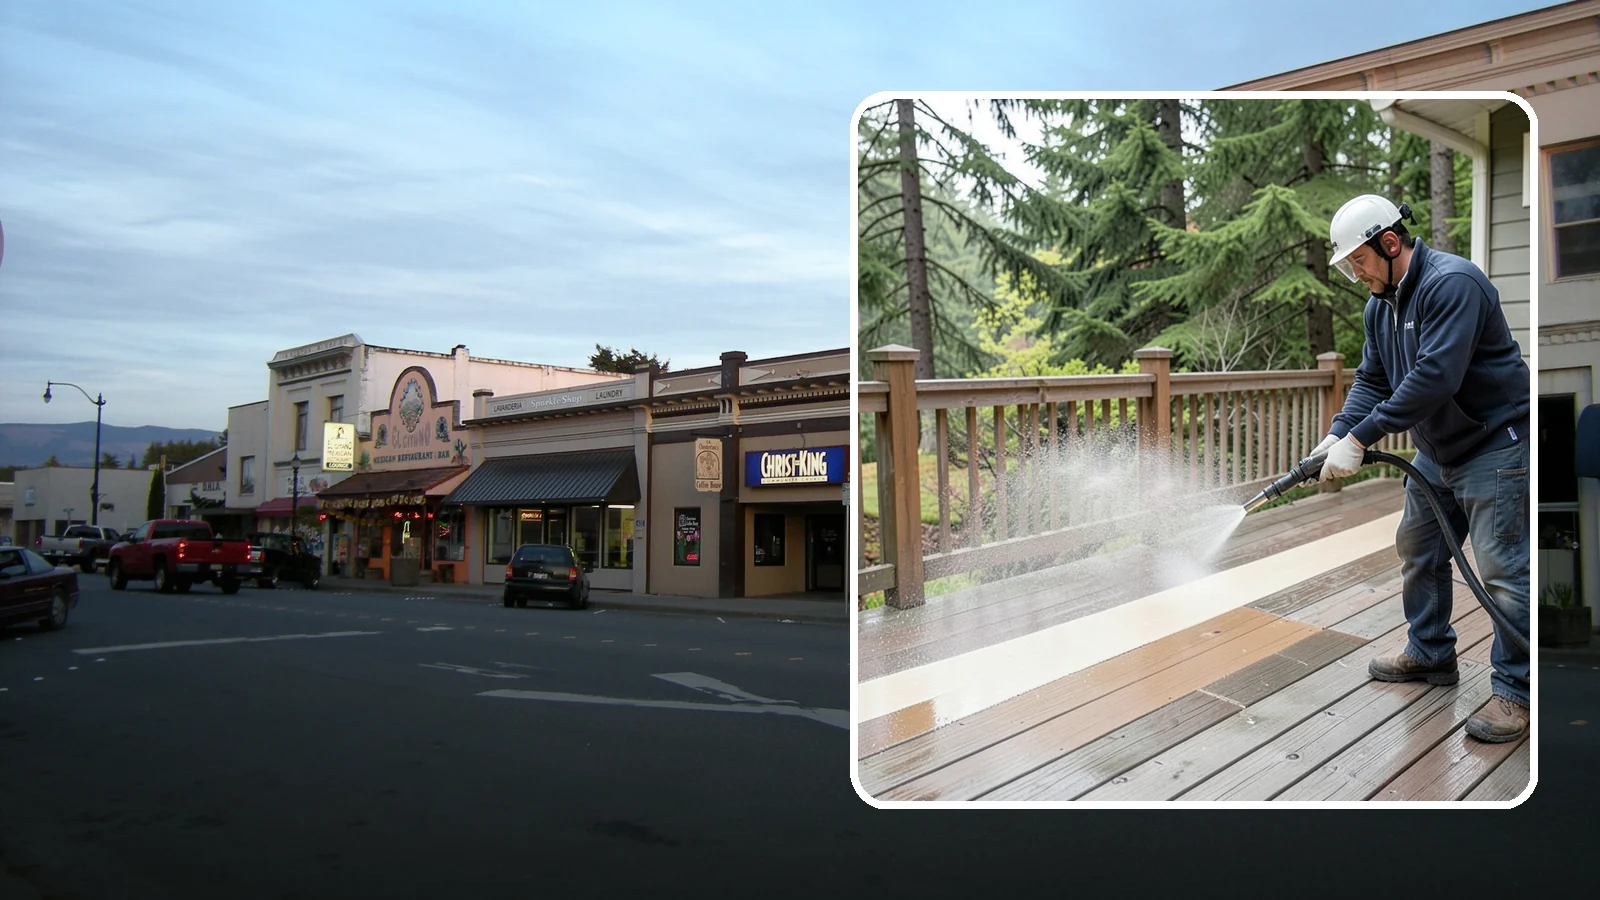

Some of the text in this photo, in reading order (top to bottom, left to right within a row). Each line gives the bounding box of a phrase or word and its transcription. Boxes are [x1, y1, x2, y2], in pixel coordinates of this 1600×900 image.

[493, 389, 624, 412] LAVANDERIA Sparkle Shop LAUNDRY
[373, 454, 396, 464] MEXICAN
[397, 451, 433, 462] RESTAURANT
[438, 450, 450, 459] BAR
[761, 450, 827, 477] CHRIST KING
